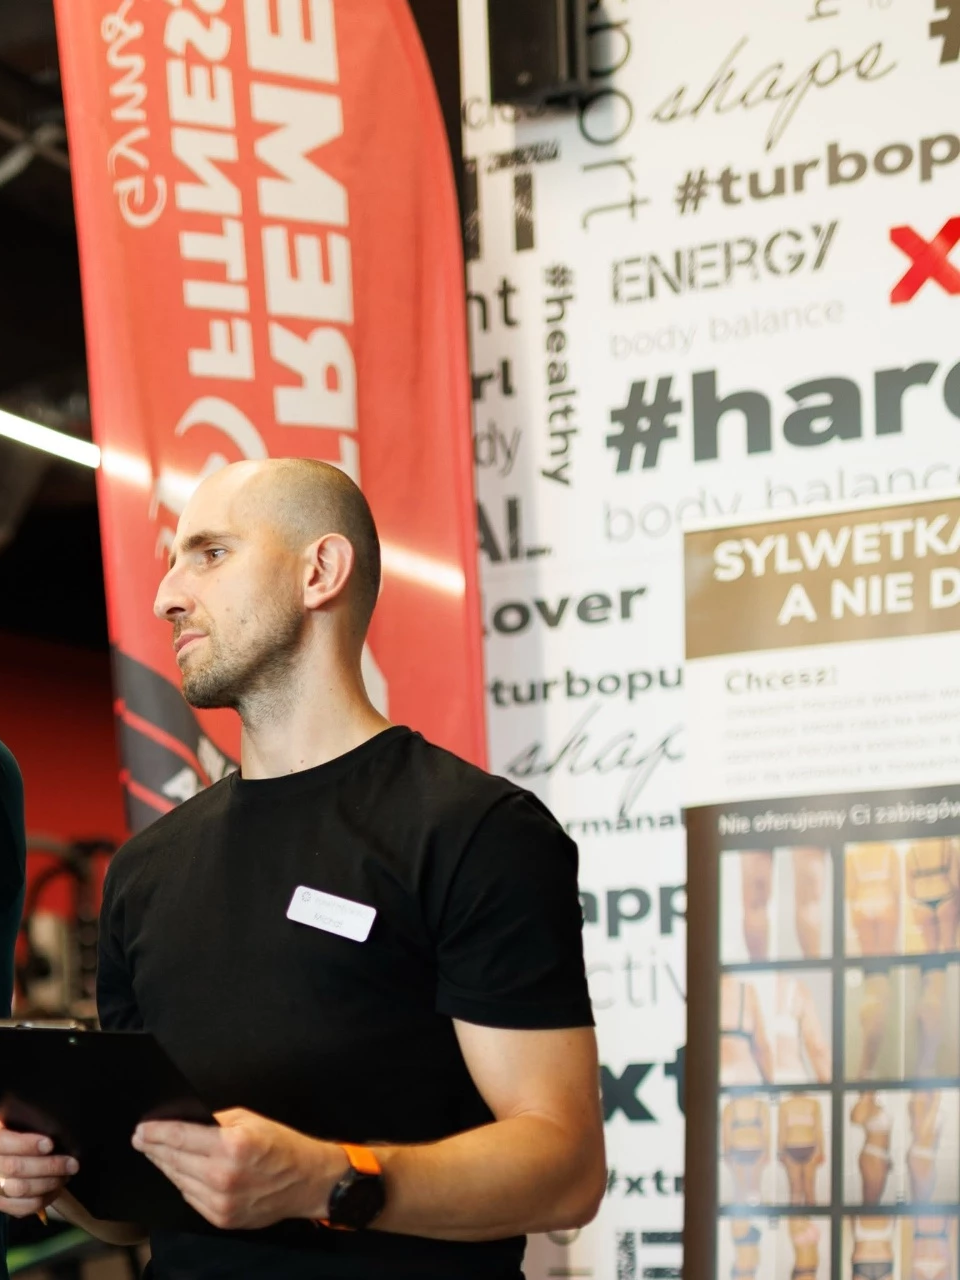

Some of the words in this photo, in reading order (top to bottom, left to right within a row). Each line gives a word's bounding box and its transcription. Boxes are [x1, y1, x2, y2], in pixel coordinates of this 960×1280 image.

[579, 0, 648, 230] port
[650, 35, 895, 153] shape
[675, 131, 960, 214] #turbop
[611, 219, 840, 305] ENERGY
[542, 264, 577, 487] #healthy
[486, 585, 647, 637] over
[776, 582, 819, 627] A
[830, 572, 915, 620] NIE
